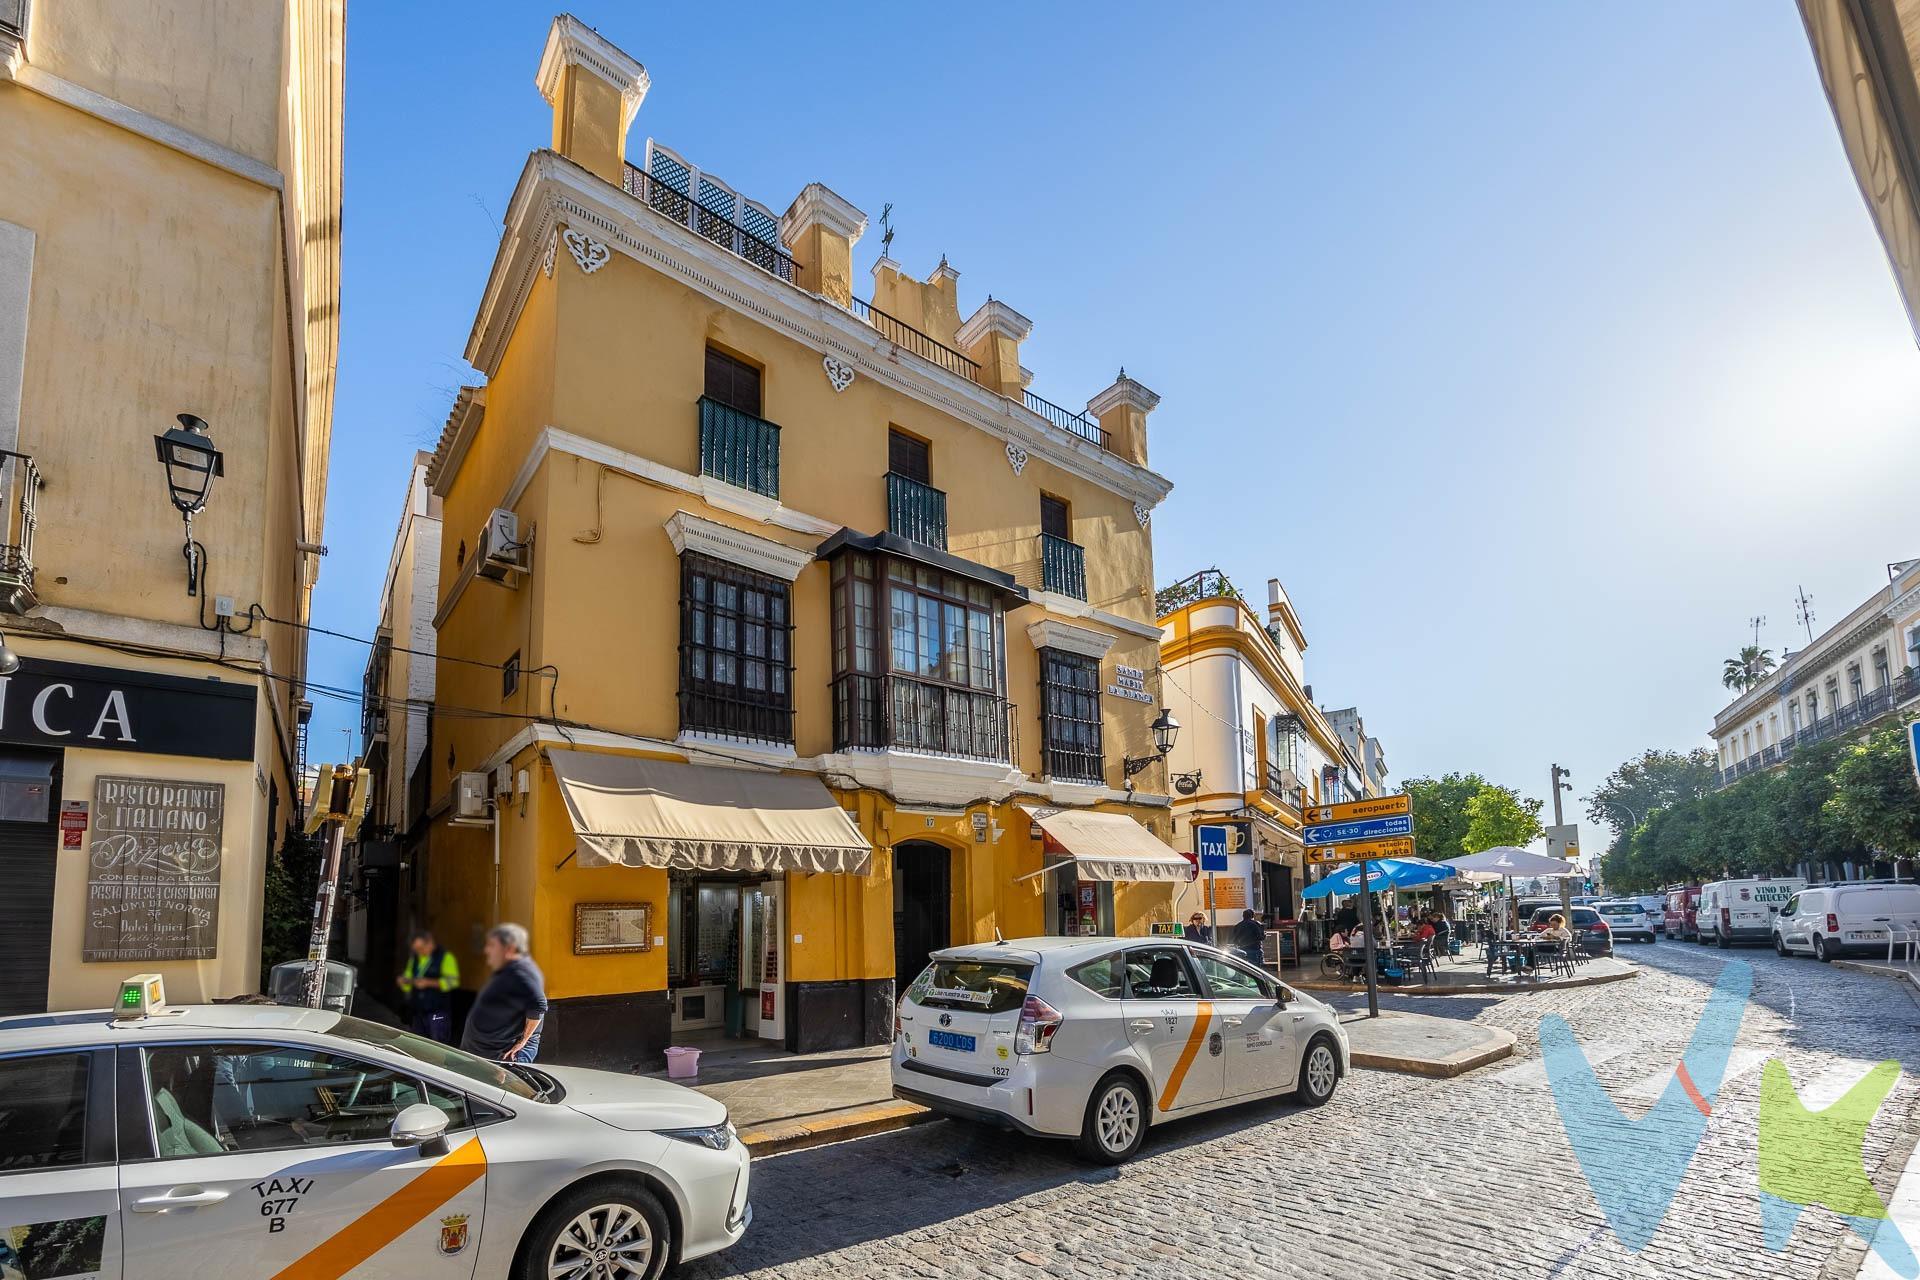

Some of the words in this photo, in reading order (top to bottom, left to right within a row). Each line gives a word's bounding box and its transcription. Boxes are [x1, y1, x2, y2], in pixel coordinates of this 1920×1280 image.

[105, 782, 217, 808] RISTORANTE
[1352, 802, 1406, 815] aeropuerto
[115, 806, 208, 831] ITALIANO
[1336, 827, 1359, 836] SE-30
[1385, 819, 1408, 827] todas
[1363, 826, 1408, 836] direcciones
[1202, 842, 1227, 857] TAXI
[1378, 840, 1409, 849] estación
[1349, 851, 1377, 860] Santa
[1382, 848, 1410, 858] Justa
[98, 873, 123, 882] CON
[178, 874, 212, 883] LEGNA
[91, 884, 122, 900] PASTA
[1755, 886, 1777, 894] VINO
[1779, 885, 1793, 893] DE
[92, 901, 146, 919] SALUMI
[164, 900, 212, 920] NORCIA
[1164, 1017, 1178, 1026] 1827
[932, 1031, 954, 1047] 6200
[991, 1066, 1010, 1077] 1827
[250, 1177, 315, 1198] TAXI
[260, 1197, 299, 1217] 677
[269, 1217, 286, 1234] B
